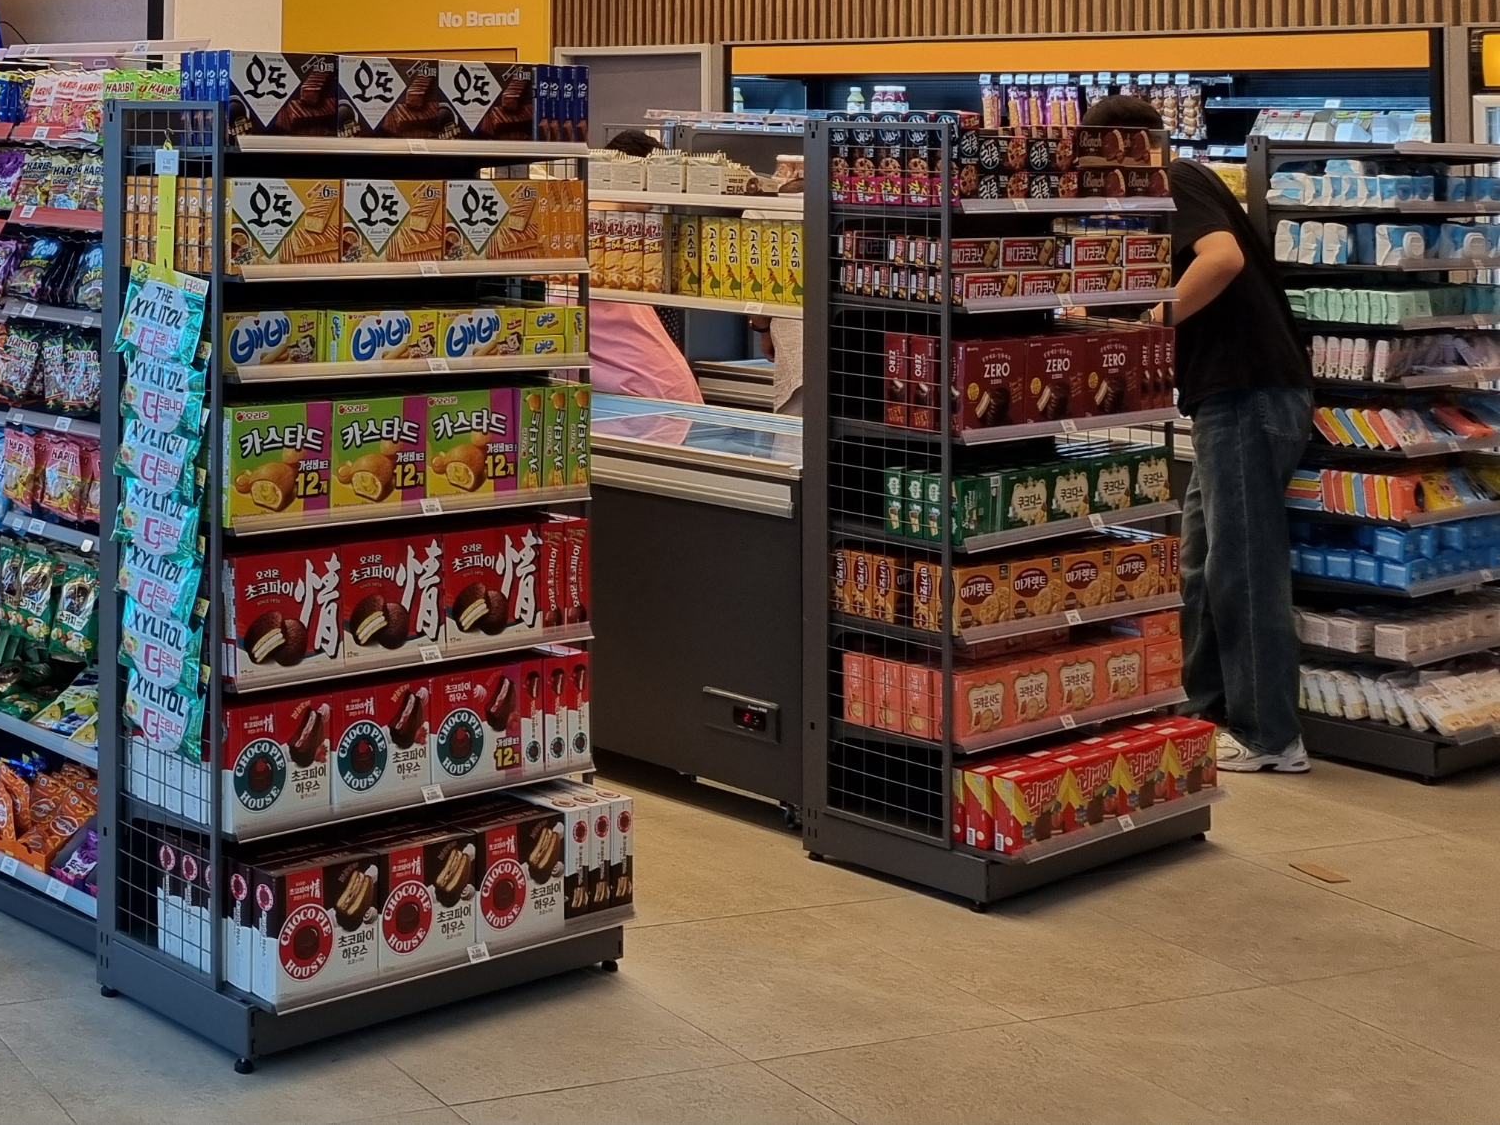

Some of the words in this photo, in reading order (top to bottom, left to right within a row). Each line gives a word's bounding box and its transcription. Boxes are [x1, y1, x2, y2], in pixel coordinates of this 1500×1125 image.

[438, 11, 463, 27] No
[465, 8, 520, 27] Brand
[104, 81, 136, 93] HARIBO
[243, 53, 288, 100] 오뜨
[350, 58, 395, 104] 오뜨
[451, 63, 491, 106] 오뜨
[1079, 130, 1102, 147] Binch
[1083, 171, 1105, 188] Binch
[1128, 170, 1149, 187] Binch
[247, 182, 293, 228] 오뜨
[357, 182, 400, 228] 오뜨
[458, 183, 499, 227] 오뜨
[686, 224, 698, 259] 고소미
[708, 226, 718, 263] 고소미
[728, 227, 739, 265] 고소미
[749, 229, 760, 266] 고소미
[770, 230, 781, 268] 고소미
[155, 286, 175, 303] THE
[130, 296, 183, 330] XYLITOL
[889, 349, 897, 374] ZERO
[914, 353, 922, 377] ZERO
[984, 362, 1011, 378] ZERO
[1045, 358, 1071, 373] ZERO
[1102, 353, 1126, 367] ZERO
[129, 361, 185, 393] XYLITOL
[244, 410, 269, 422] 오리온
[346, 403, 370, 414] 오리온
[341, 416, 420, 450] 카스타드
[432, 408, 507, 440] 카스타드
[132, 420, 183, 457] XYLITOL
[239, 423, 325, 458] 카스타드
[1102, 481, 1126, 494] 쿠크다스
[1142, 472, 1164, 485] 쿠크다스
[130, 485, 184, 521] XYLITOL
[1017, 496, 1043, 508] 쿠크다스
[1060, 487, 1084, 500] 쿠크다스
[128, 546, 186, 584] XYLITOL
[349, 566, 396, 585] 초코파이
[451, 553, 495, 573] 초코파이
[1065, 567, 1098, 583] 마가렛트
[1115, 560, 1147, 576] 마가렛트
[244, 580, 295, 600] 초코파이
[396, 538, 443, 639] 情
[495, 528, 538, 629] 情
[960, 582, 994, 598] 마가렛트
[1013, 576, 1047, 591] 마가렛트
[295, 552, 341, 658] 情
[131, 608, 182, 652] XYLITOL
[1064, 671, 1091, 686] 크라운산도
[1111, 663, 1137, 677] 크라운산도
[449, 693, 468, 703] 하우스
[973, 693, 1000, 709] 크라운산도
[1018, 681, 1044, 698] 크라운산도
[438, 711, 469, 745] CHOCO
[468, 716, 483, 739] PIE
[338, 724, 371, 758] CHOCO
[369, 727, 386, 752] PIE
[235, 741, 271, 778] CHOCO
[269, 745, 285, 771] PIE
[392, 746, 427, 764] 초코파이
[442, 752, 479, 775] HOUSE
[1129, 745, 1163, 787] 빅파이
[1177, 732, 1211, 777] 빅파이
[290, 765, 327, 783] 초코파이
[344, 766, 382, 789] HOUSE
[396, 761, 422, 776] 하우스
[1077, 759, 1113, 802] 빅파이
[239, 786, 282, 811] HOUSE
[295, 780, 321, 795] 하우스
[1024, 774, 1062, 818] 빅파이
[481, 863, 511, 898] CHOCO
[383, 884, 417, 922] CHOCO
[416, 887, 432, 912] PIE
[485, 903, 521, 928] HOUSE
[533, 897, 557, 911] 하우스
[280, 909, 315, 946] CHOCO
[315, 911, 333, 938] PIE
[387, 927, 426, 952] HOUSE
[440, 920, 466, 935] 하우스
[341, 944, 369, 960] 하우스
[285, 952, 326, 979] HOUSE
